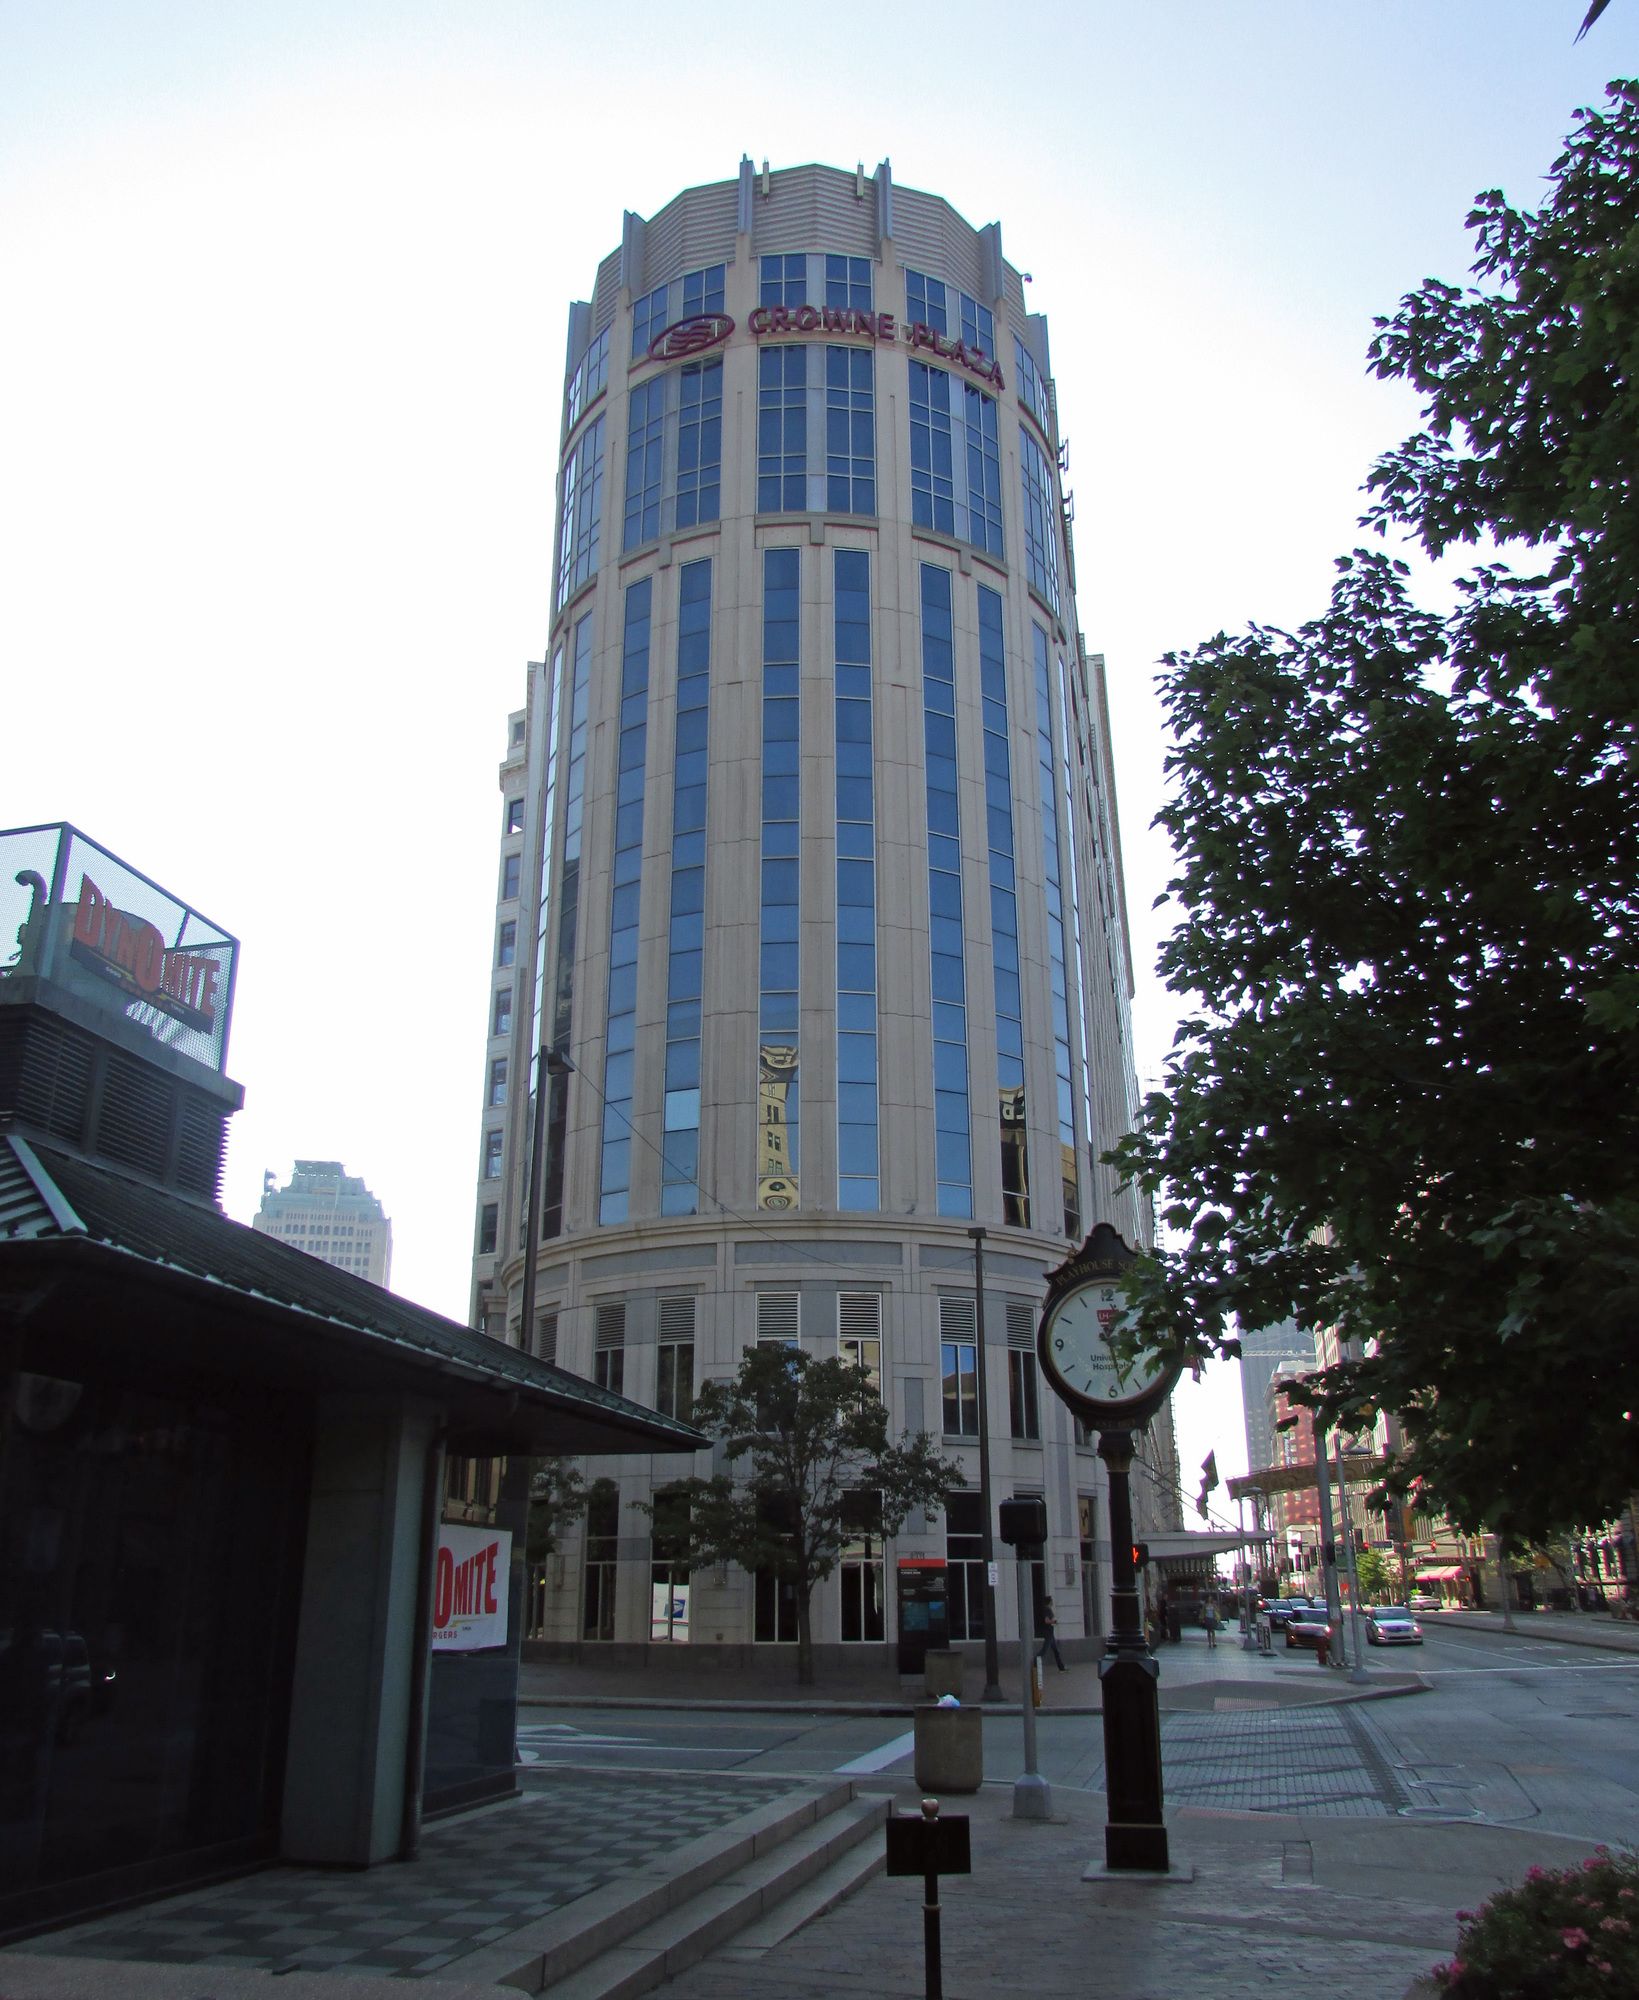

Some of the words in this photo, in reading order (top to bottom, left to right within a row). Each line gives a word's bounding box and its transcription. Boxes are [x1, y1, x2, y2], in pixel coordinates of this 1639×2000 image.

[748, 304, 895, 341] CROWNE
[910, 321, 1006, 391] PLAZA
[1055, 1258, 1114, 1287] PLAYHOUSE
[1101, 1288, 1114, 1302] 12
[1055, 1338, 1064, 1351] 9
[1108, 1385, 1118, 1399] 6
[434, 1541, 499, 1629] OMITE
[432, 1630, 458, 1640] RGERS
